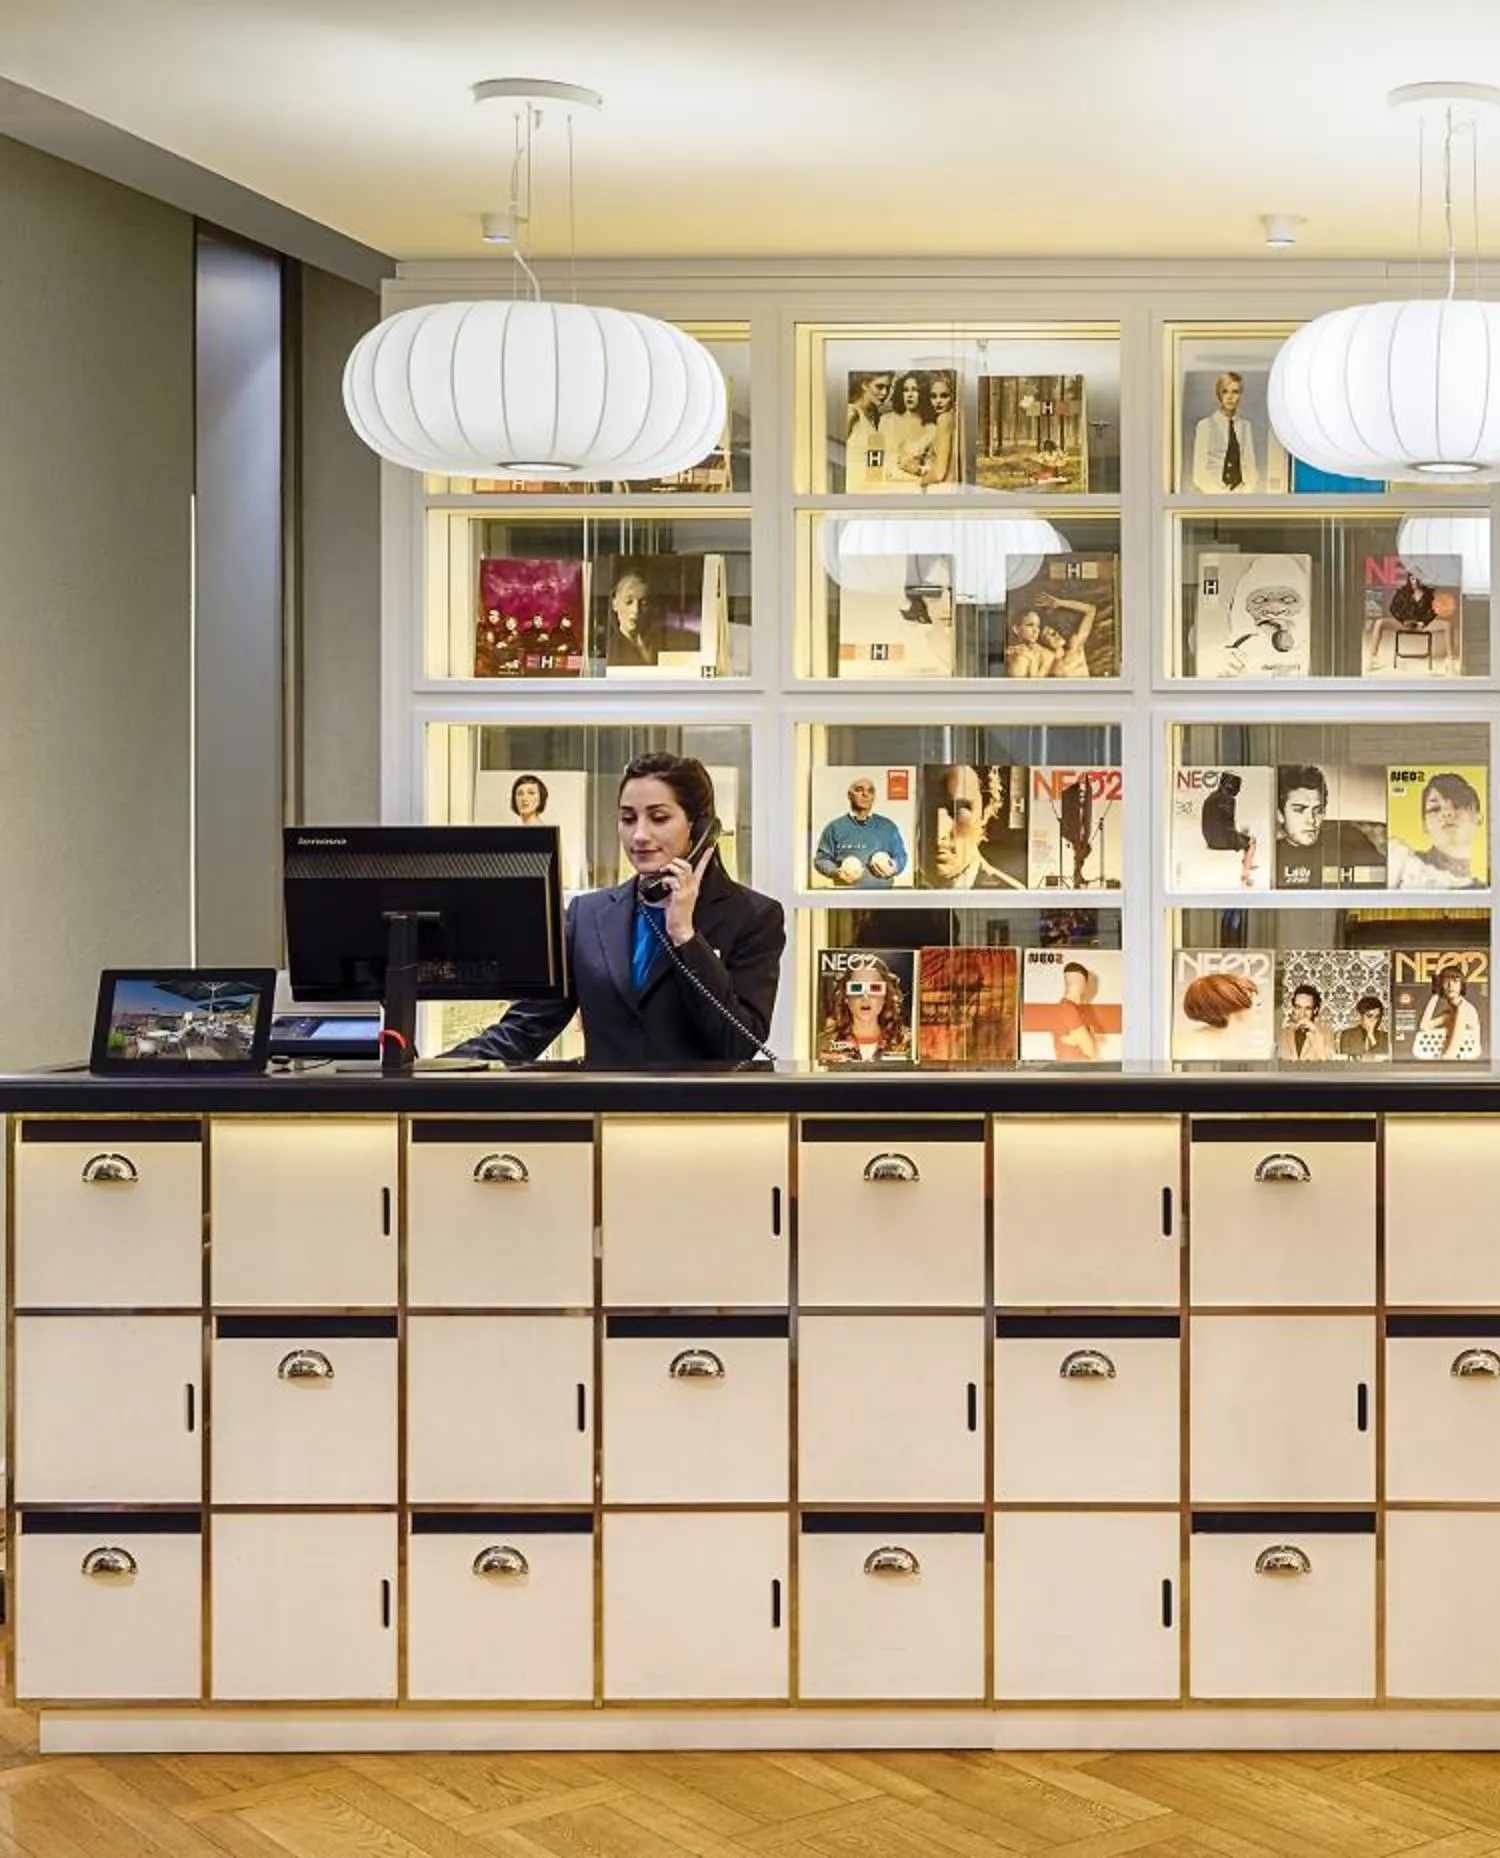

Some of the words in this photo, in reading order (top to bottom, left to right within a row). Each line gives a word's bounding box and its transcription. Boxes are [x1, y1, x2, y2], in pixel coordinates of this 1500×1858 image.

[1042, 402, 1053, 415] H
[870, 452, 881, 466] H
[680, 470, 692, 483] H
[1068, 563, 1080, 578] H
[1205, 581, 1217, 594] H
[873, 645, 886, 659] H
[542, 656, 553, 669] H
[1177, 769, 1219, 788] NEO
[1391, 771, 1425, 783] NEO2
[298, 836, 347, 845] lenovo
[1341, 867, 1353, 882] H
[821, 953, 877, 971] NEO2
[1028, 953, 1064, 965] NEO2
